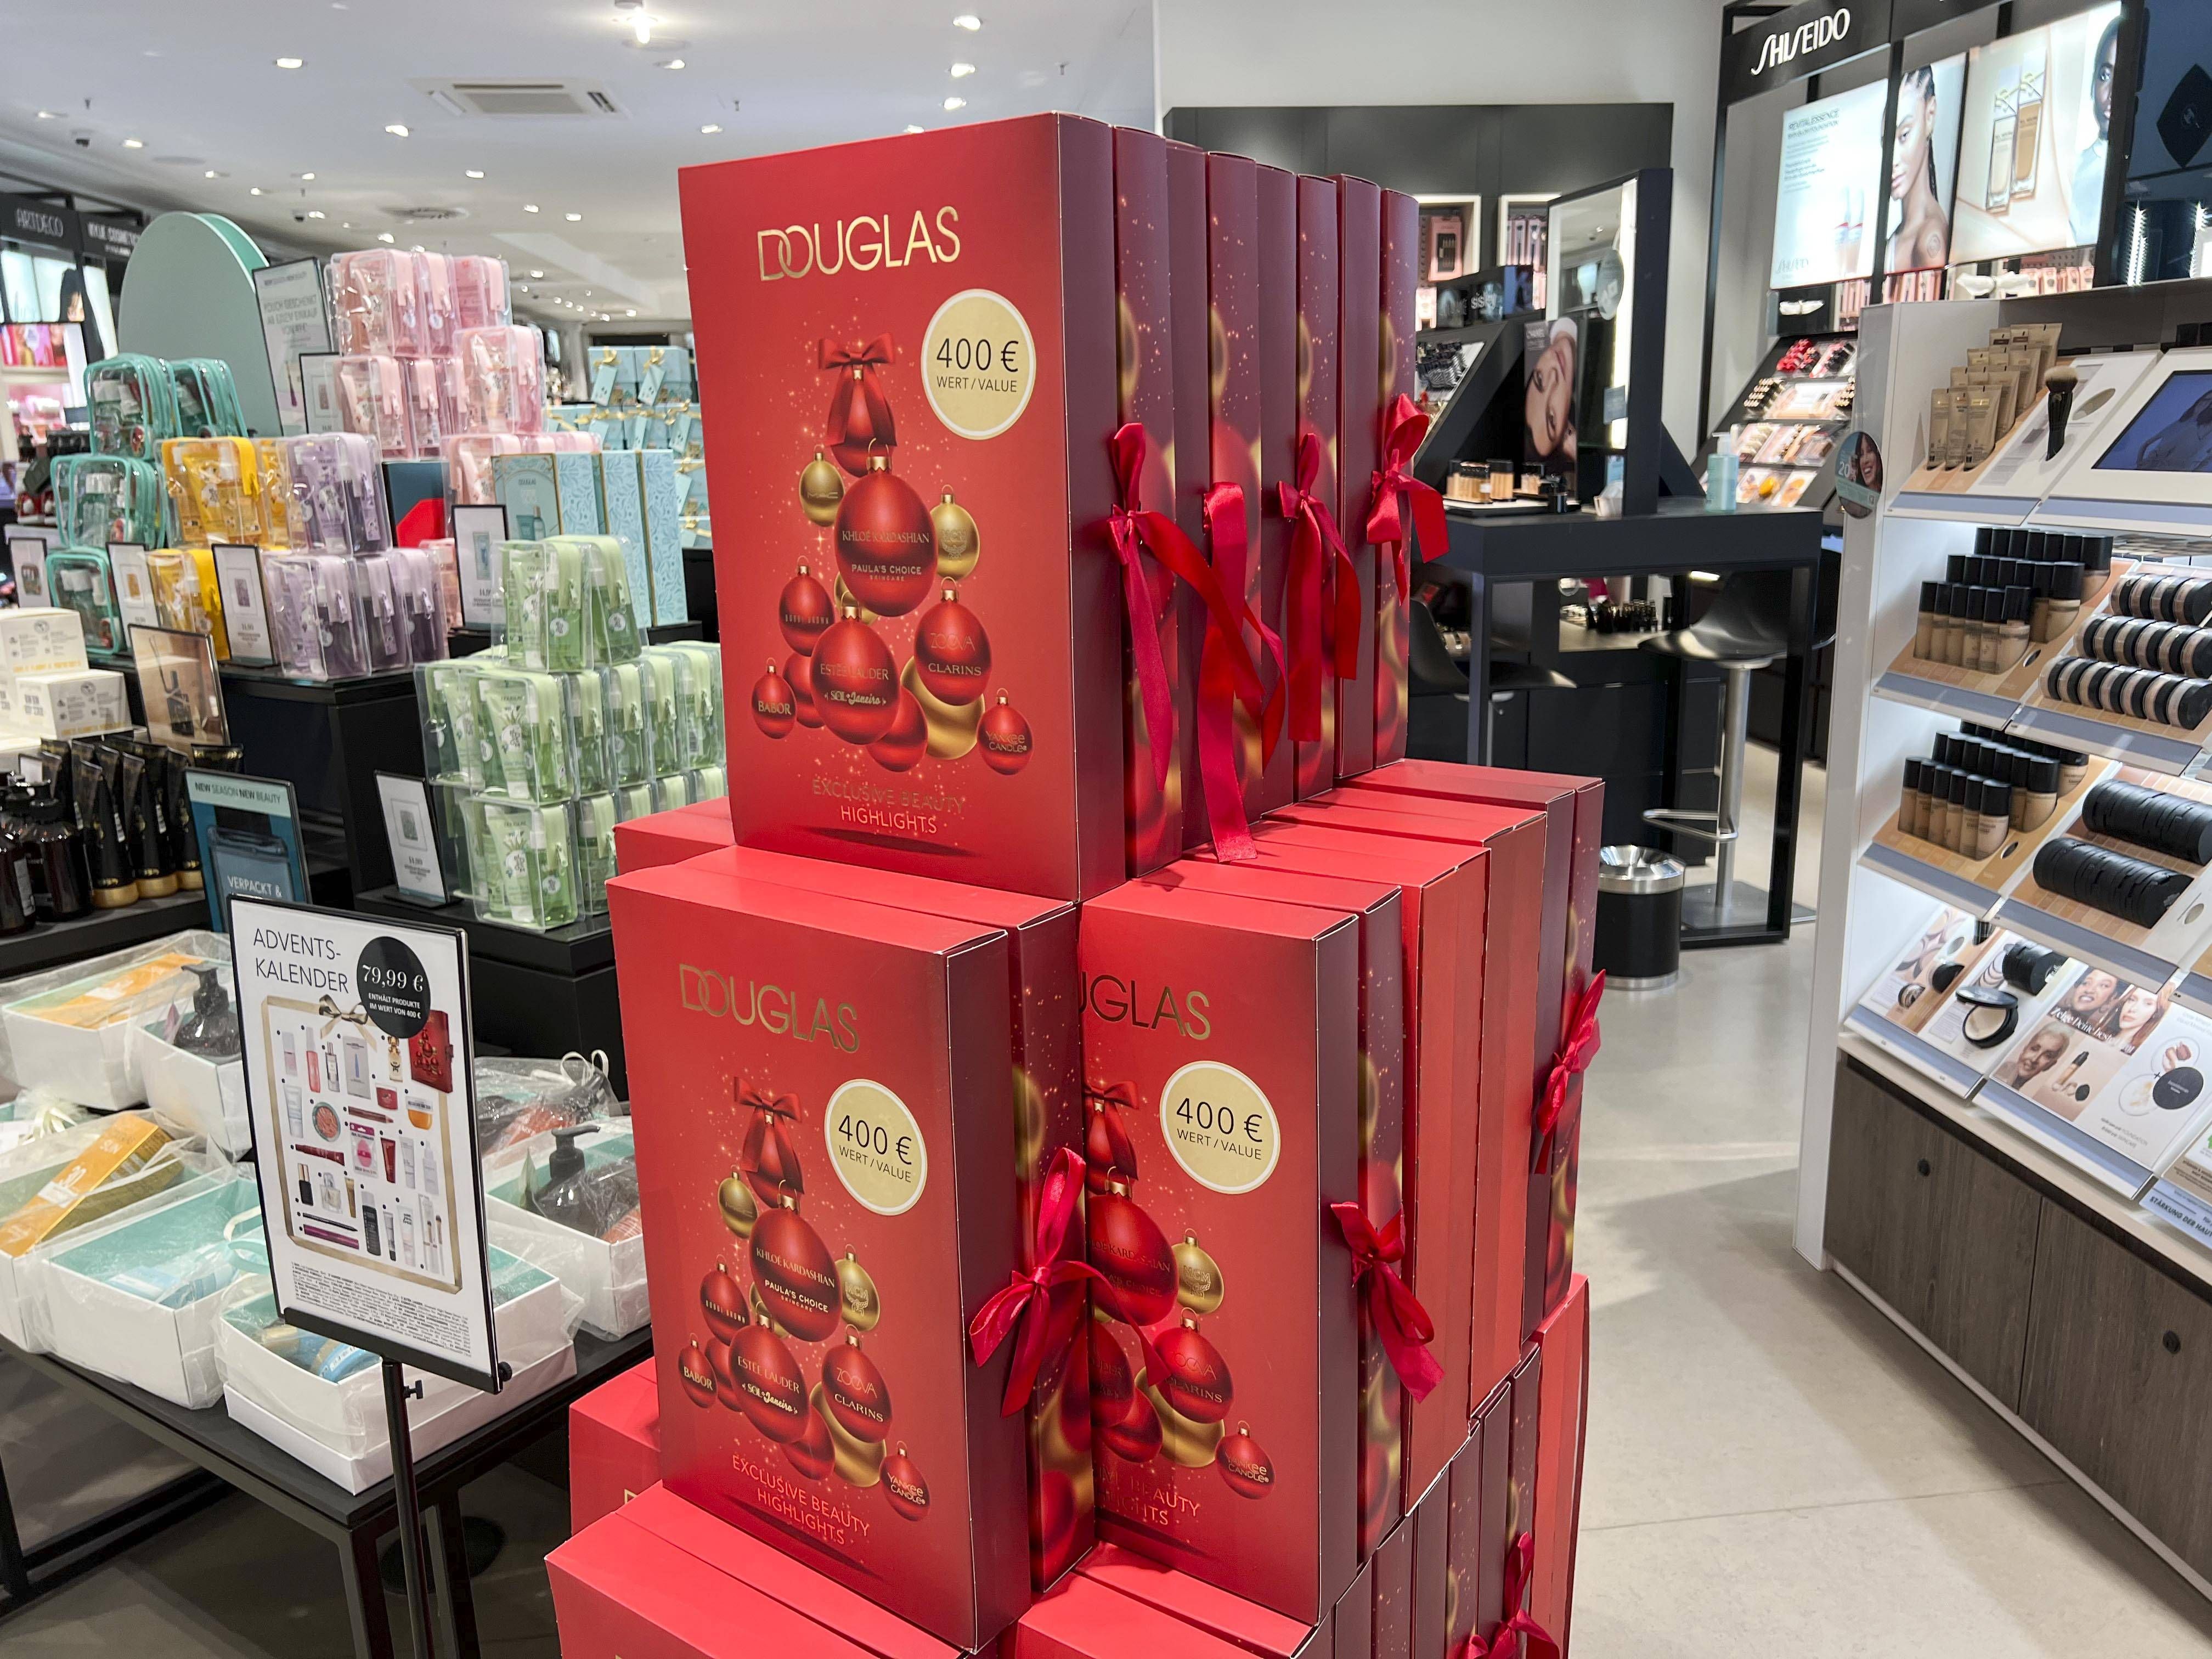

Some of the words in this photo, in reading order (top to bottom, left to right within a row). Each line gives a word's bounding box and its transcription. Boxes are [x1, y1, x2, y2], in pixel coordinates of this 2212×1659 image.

[1750, 8, 1850, 76] SHISEIDO
[757, 206, 961, 281] DOUGLAS
[936, 338, 992, 370] 400
[1001, 340, 1019, 373] €
[936, 376, 969, 390] WERT
[978, 378, 1018, 393] VALUE
[851, 564, 887, 573] PAULA'S
[889, 566, 922, 575] CHOICE
[928, 663, 981, 676] CLARINS
[758, 701, 792, 715] BABOR
[195, 782, 211, 792] NEW
[211, 783, 238, 797] SEASON
[239, 788, 255, 799] NEW
[256, 791, 281, 803] BEAUTY
[812, 778, 895, 805] EXCLUSIVE
[900, 788, 966, 814] BEAUTY
[840, 805, 938, 834] HIGHLIGHTS
[227, 876, 272, 896] VERPACKT
[275, 887, 283, 898] &
[253, 928, 341, 960] ADVENTS-
[255, 958, 349, 994] KALENDER
[363, 964, 407, 989] 79,99
[413, 975, 423, 992] €
[368, 992, 391, 1003] ENTHÄLT
[392, 997, 420, 1009] PRODUKTE
[378, 1004, 393, 1013] WERT
[394, 1008, 405, 1016] VON
[407, 1010, 416, 1018] 400
[679, 964, 860, 1053] DOUGLAS
[1176, 1098, 1234, 1135] 400
[1244, 1114, 1263, 1142] €
[838, 1115, 888, 1155] 400
[895, 1136, 912, 1165] €
[1177, 1128, 1211, 1145] WERT
[1221, 1140, 1262, 1160] VALUE
[839, 1145, 868, 1165] WERT
[876, 1159, 911, 1183] VALUE
[2149, 1196, 2183, 1219] STÄRKUNG
[2182, 1215, 2196, 1227] DER
[783, 1259, 835, 1288] KARDASHIAN
[1183, 1265, 1211, 1284] MCM
[765, 1279, 797, 1300] PAULA'S
[799, 1294, 828, 1313] CHOICE
[845, 1282, 868, 1299] MCM
[683, 1367, 713, 1390] BABOR
[764, 1369, 800, 1394] LAUDER
[763, 1392, 793, 1412] Janeiro
[834, 1393, 883, 1423] CLARINS
[732, 1454, 807, 1506] EXCLUSIVE
[811, 1494, 870, 1537] BEAUTY
[758, 1487, 845, 1545] HIGHLIGHTS
